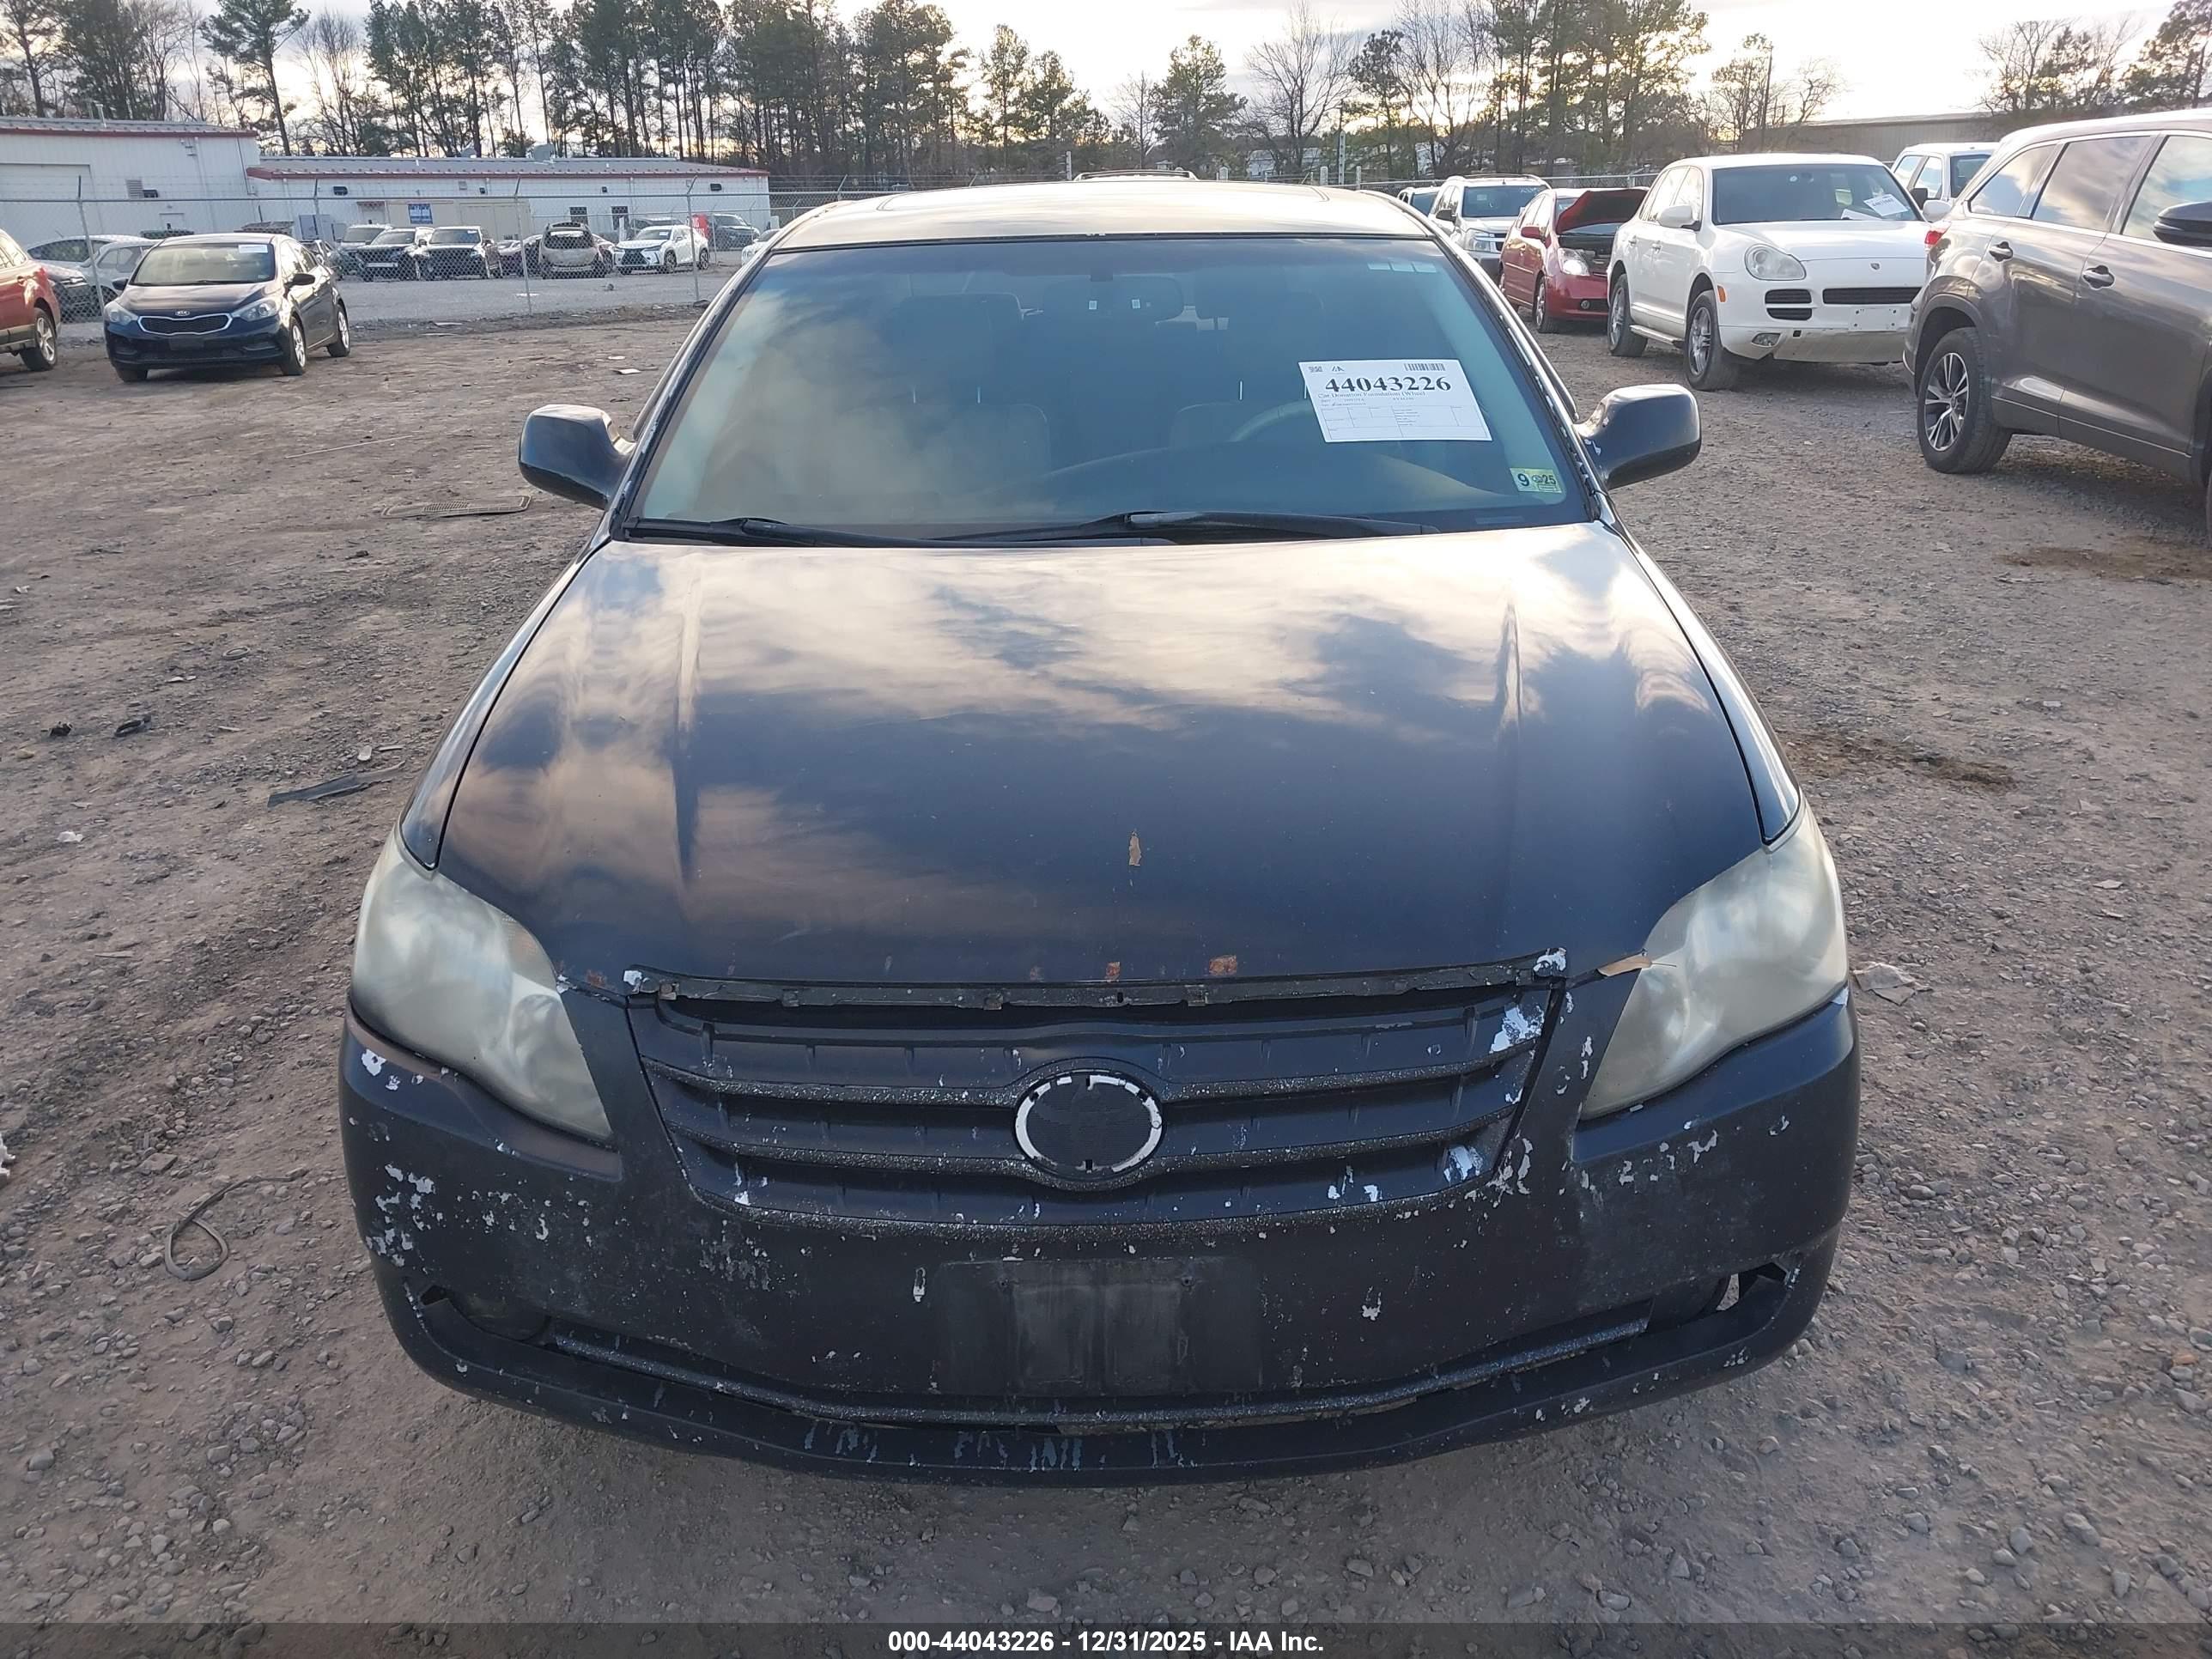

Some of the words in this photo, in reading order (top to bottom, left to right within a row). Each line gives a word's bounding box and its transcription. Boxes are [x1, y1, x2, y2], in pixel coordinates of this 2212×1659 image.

[1325, 376, 1451, 392] 44043226
[1517, 473, 1530, 487] 9
[1542, 474, 1557, 485] 25
